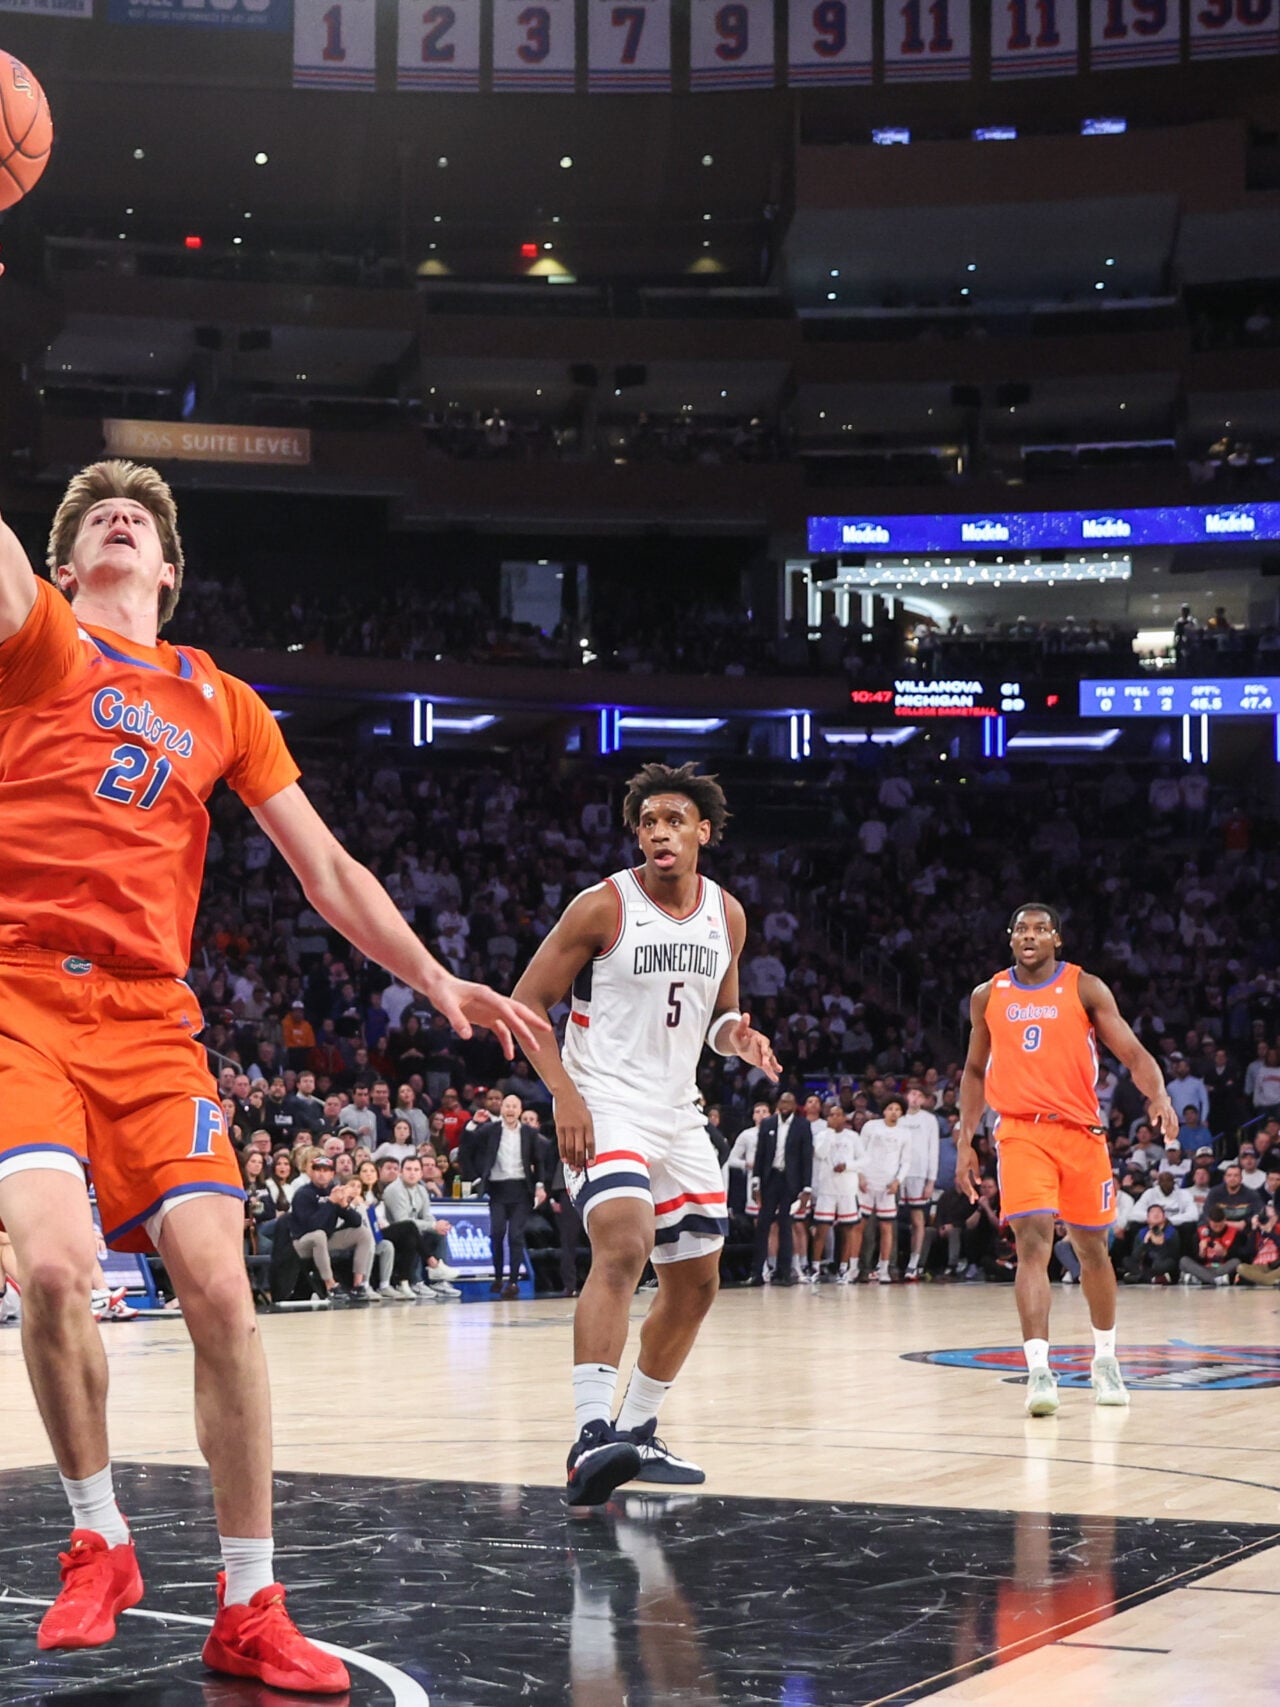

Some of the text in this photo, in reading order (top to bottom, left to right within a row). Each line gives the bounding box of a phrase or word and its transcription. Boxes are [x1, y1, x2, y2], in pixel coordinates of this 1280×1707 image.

[322, 4, 346, 61] 1
[422, 5, 456, 62] 2
[517, 5, 551, 63] 3
[610, 8, 646, 63] 7
[715, 4, 749, 60] 9
[813, 0, 847, 57] 9
[900, 0, 954, 54] 11
[1007, 0, 1061, 49] 11
[181, 433, 238, 451] SUITE
[244, 437, 303, 456] LEVEL
[851, 690, 893, 703] 10:47
[894, 680, 1020, 696] VILLANOVA 61
[894, 694, 974, 707] MICHIGAN
[894, 706, 998, 716] COLLEGE BASKETBALL
[1100, 697, 1112, 712] 0
[1133, 697, 1142, 711] 1
[1161, 697, 1173, 711] 2
[1240, 696, 1273, 710] 47.4
[92, 686, 194, 758] Gators
[94, 742, 173, 809] 21
[633, 943, 719, 979] CONNECTICUT
[666, 981, 685, 1028] 5
[1006, 1002, 1059, 1022] Gators
[1022, 1024, 1042, 1052] 9
[186, 1096, 223, 1159] F
